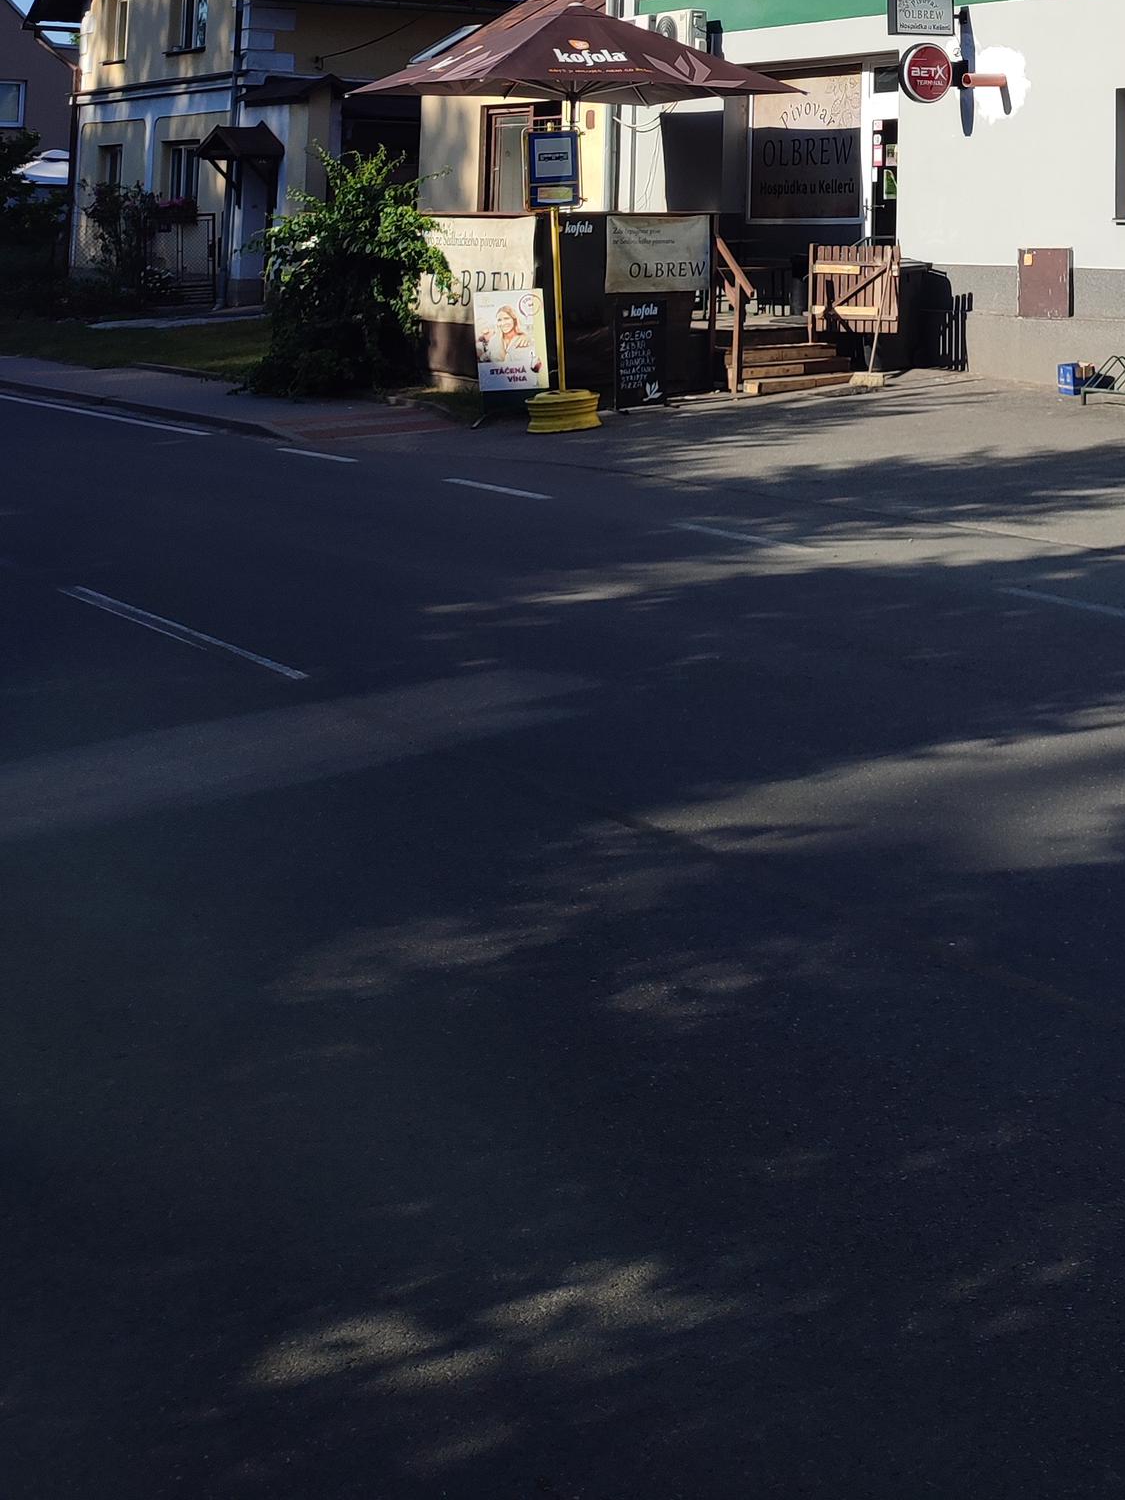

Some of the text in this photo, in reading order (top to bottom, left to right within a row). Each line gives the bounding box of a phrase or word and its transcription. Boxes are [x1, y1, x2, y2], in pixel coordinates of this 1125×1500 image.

[903, 9, 944, 21] OLBREW
[552, 48, 628, 66] kofola
[780, 101, 836, 129] Pivovar
[762, 135, 853, 168] OLBREW
[760, 177, 855, 198] Hospůdka u Kellerů
[564, 220, 593, 236] kofola
[629, 261, 706, 279] OLBREW
[630, 303, 658, 320] kofola
[489, 365, 527, 375] STÁČENÁ
[507, 375, 527, 383] VÍNA
